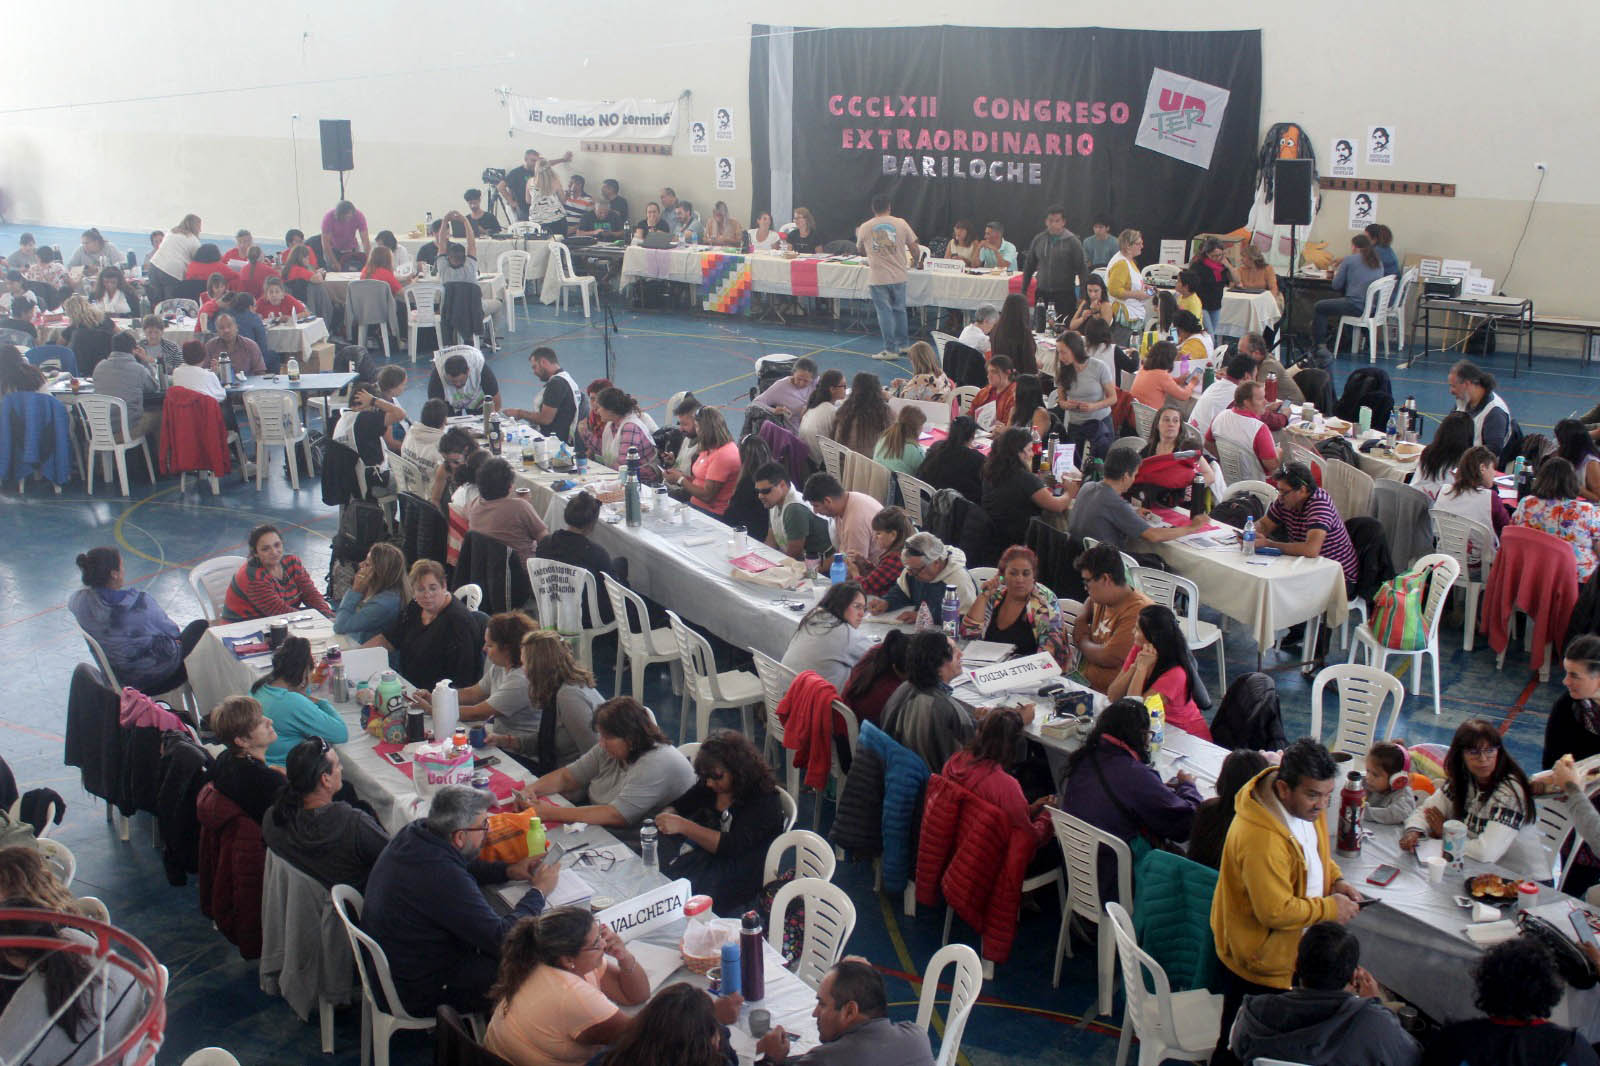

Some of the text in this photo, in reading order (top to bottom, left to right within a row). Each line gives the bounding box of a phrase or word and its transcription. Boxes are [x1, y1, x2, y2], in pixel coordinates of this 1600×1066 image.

[546, 112, 595, 127] conflicto
[598, 113, 619, 127] NO
[828, 94, 1130, 124] CCCLXII CONGRESO
[842, 128, 1094, 156] EXTRAORDINARIO
[882, 155, 1042, 184] BARILOCHE
[979, 663, 1038, 683] VALLE MEDIO
[611, 894, 682, 934] VALCHETA
